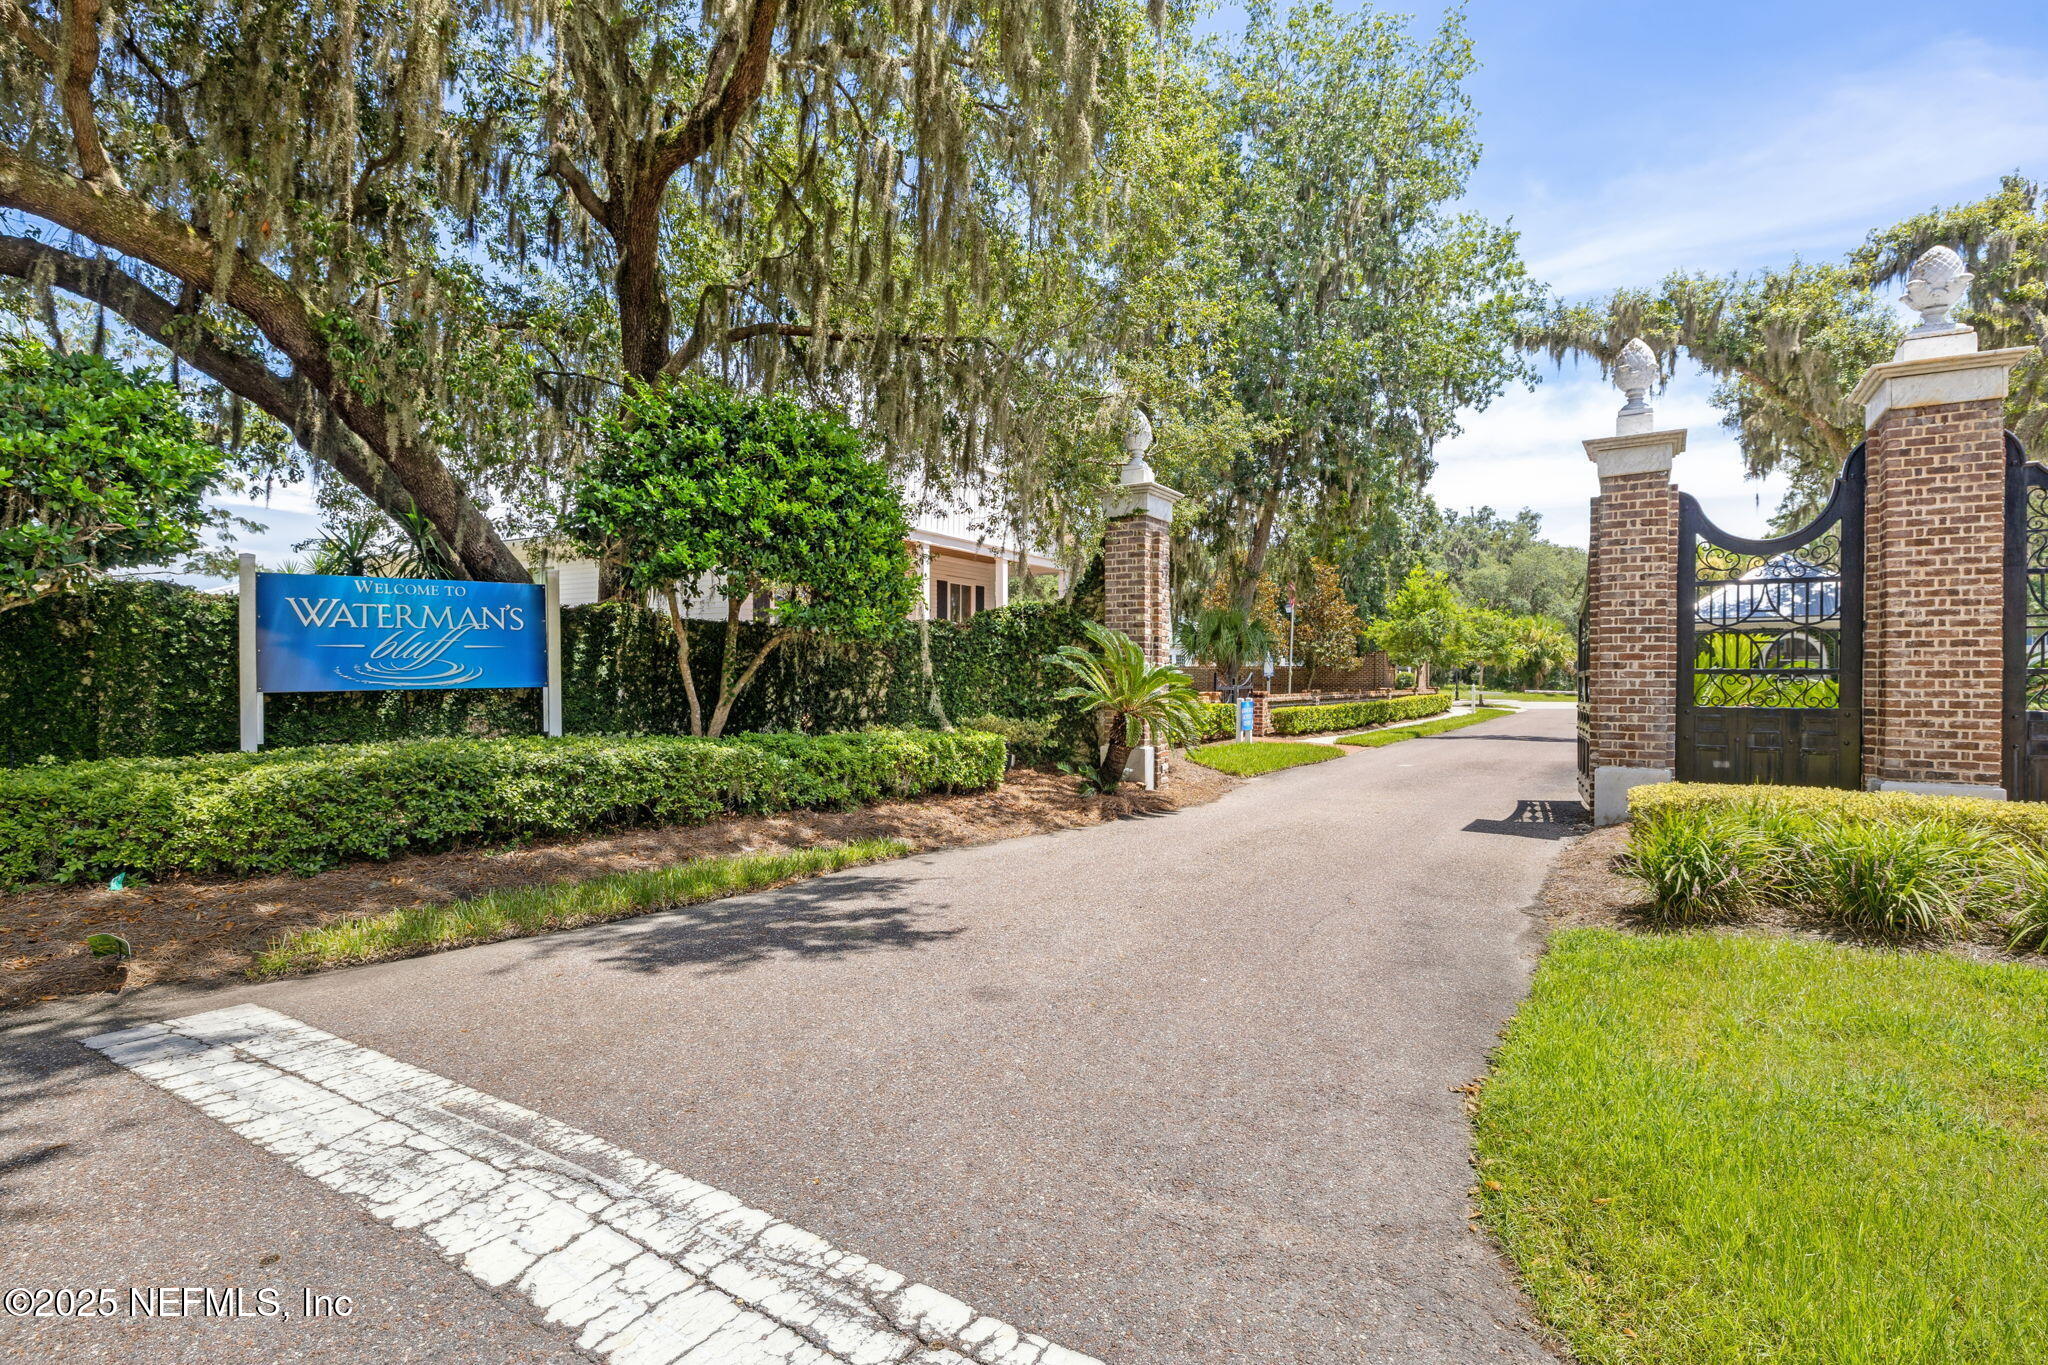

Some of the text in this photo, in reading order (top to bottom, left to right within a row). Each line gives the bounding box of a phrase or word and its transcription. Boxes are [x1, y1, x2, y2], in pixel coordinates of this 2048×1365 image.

[354, 579, 466, 598] WELCOME TO
[285, 597, 525, 632] WATERMAN'S
[370, 622, 489, 666] bluff
